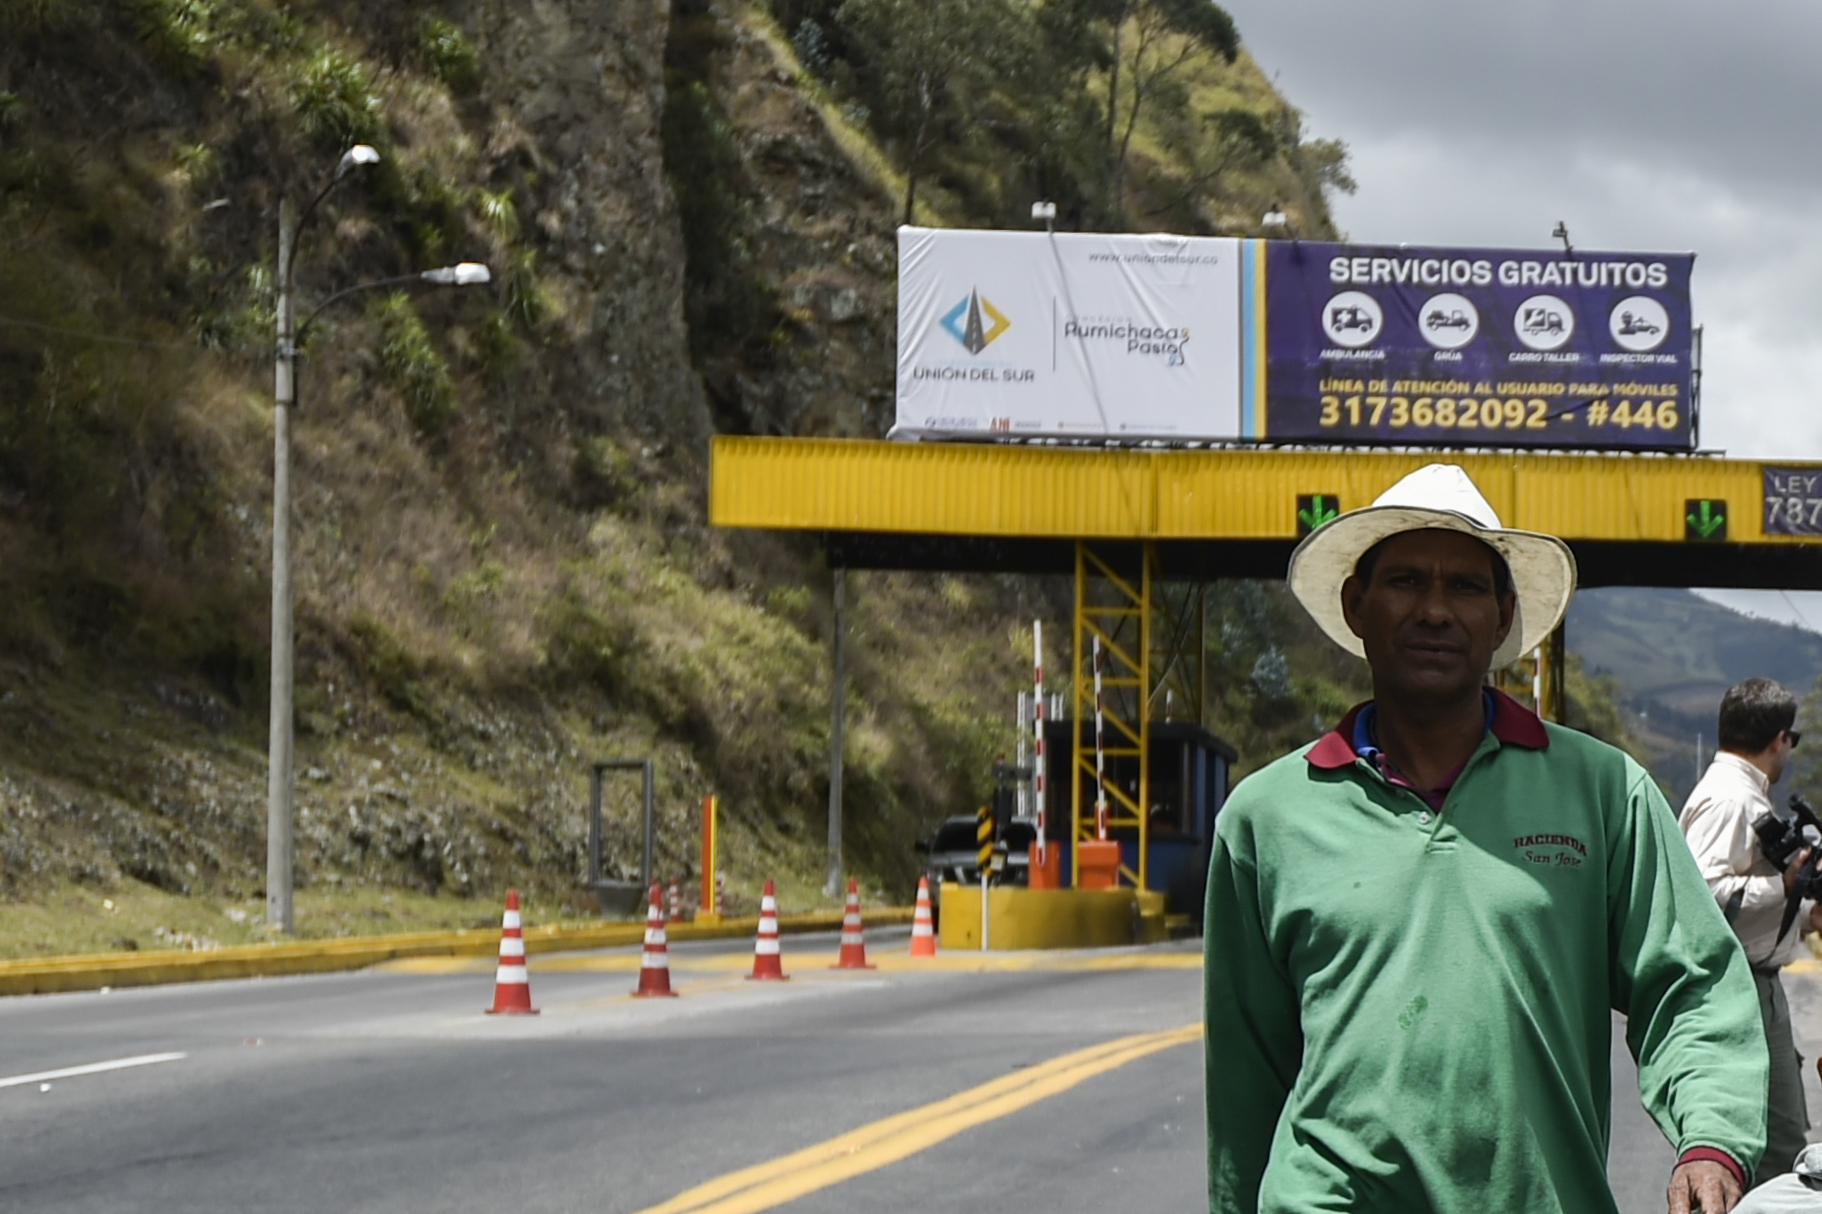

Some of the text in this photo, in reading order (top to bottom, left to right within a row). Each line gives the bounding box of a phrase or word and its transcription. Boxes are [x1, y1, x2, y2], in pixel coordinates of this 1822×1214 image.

[1329, 256, 1669, 287] SERVICIOS GRATUITOS
[1064, 320, 1179, 339] Rumichaca
[1319, 349, 1386, 360] AMBULANCIA
[1508, 353, 1580, 362] CARRO TALLER
[1600, 353, 1654, 363] INSPECTOR
[970, 368, 998, 381] DEL
[1002, 368, 1035, 382] SUR
[1319, 377, 1678, 397] LÍNEA DE ATENCIÓN AL USUARIO PARA MÓVILES
[1319, 395, 1547, 428] 3173682092
[1587, 399, 1678, 430] #446
[1774, 476, 1817, 493] LEY
[1514, 834, 1588, 857] HACIENDA
[1524, 850, 1551, 864] San
